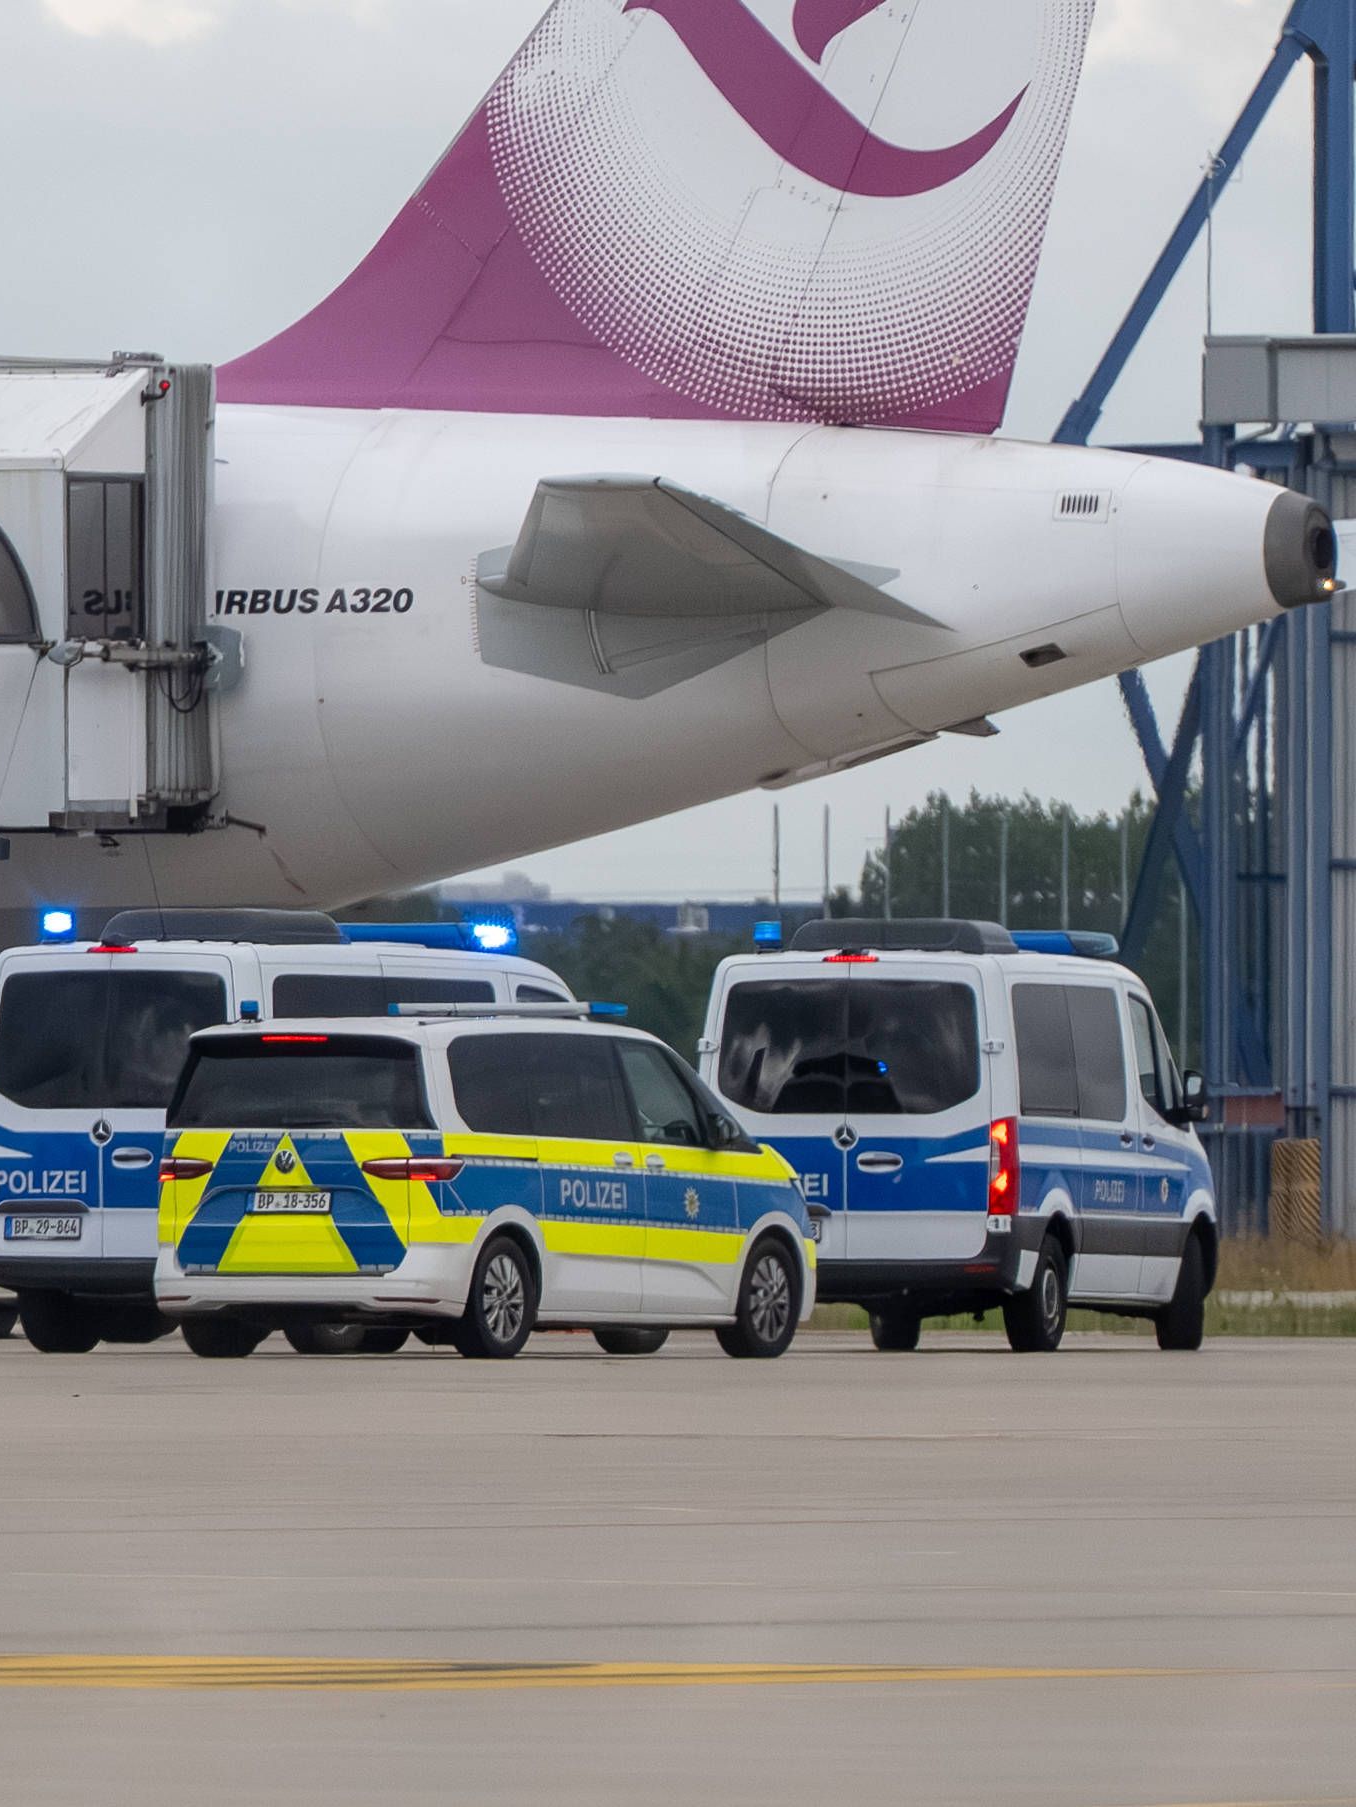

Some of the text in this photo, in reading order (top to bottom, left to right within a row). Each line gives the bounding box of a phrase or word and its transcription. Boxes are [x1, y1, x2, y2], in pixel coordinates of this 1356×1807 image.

[210, 587, 414, 616] IRBUS A320
[228, 1140, 276, 1154] POLIZEI
[560, 1178, 628, 1210] POLIZEI
[14, 1219, 78, 1235] BP 29-864
